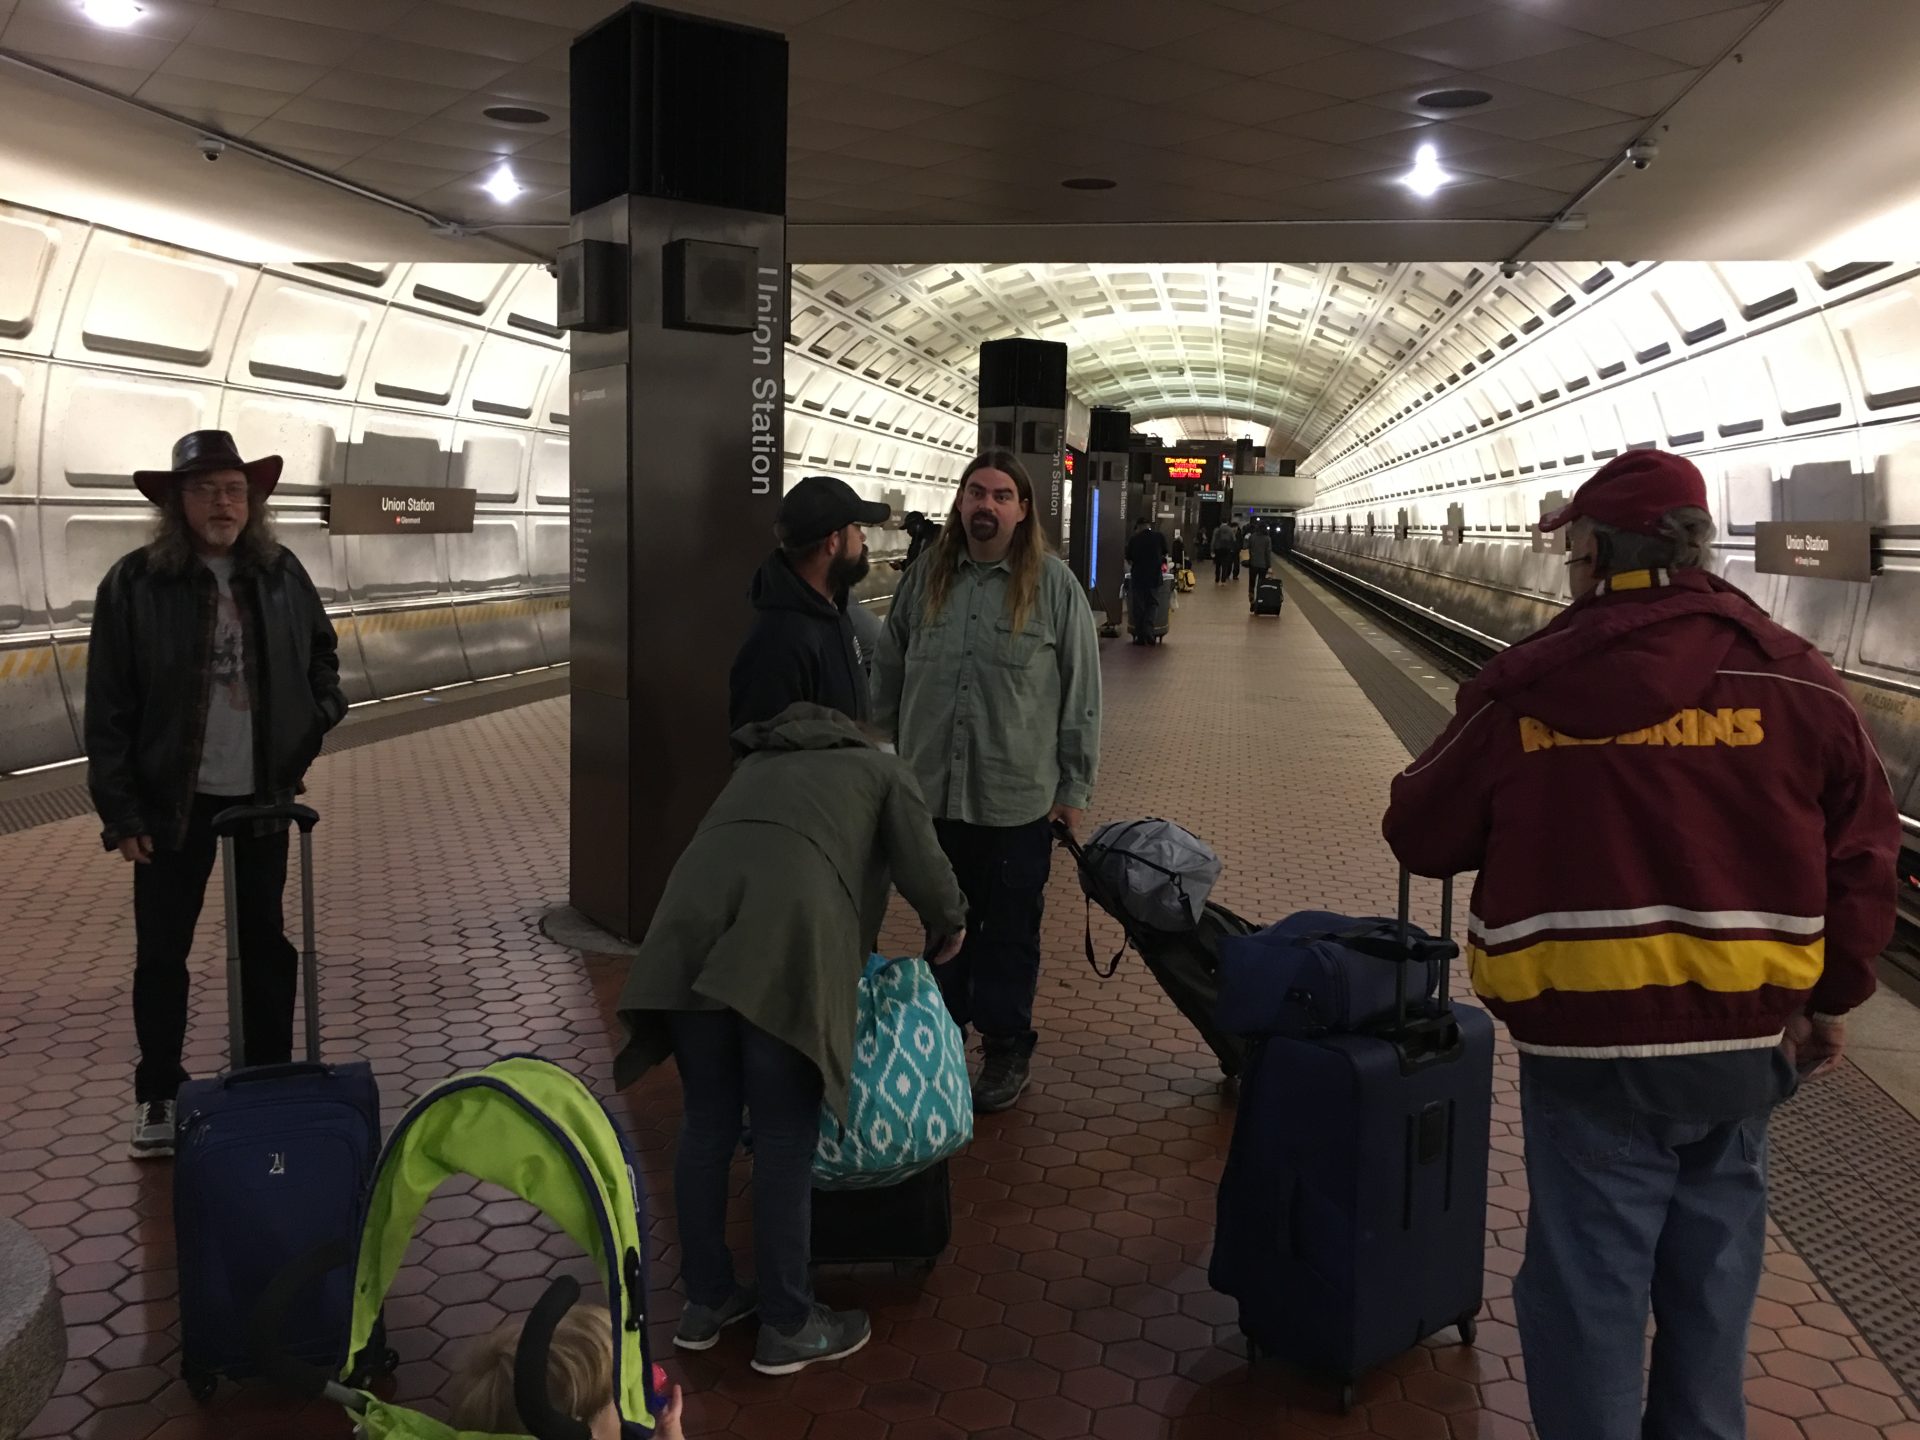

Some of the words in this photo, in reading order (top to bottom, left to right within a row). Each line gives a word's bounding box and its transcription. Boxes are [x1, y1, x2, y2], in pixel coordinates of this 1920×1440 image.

[752, 266, 779, 365] Union
[751, 376, 778, 495] Station
[381, 497, 406, 511] Union
[407, 497, 435, 511] Station
[1050, 470, 1062, 516] Station
[1786, 534, 1805, 550] Union
[1805, 535, 1829, 551] Station
